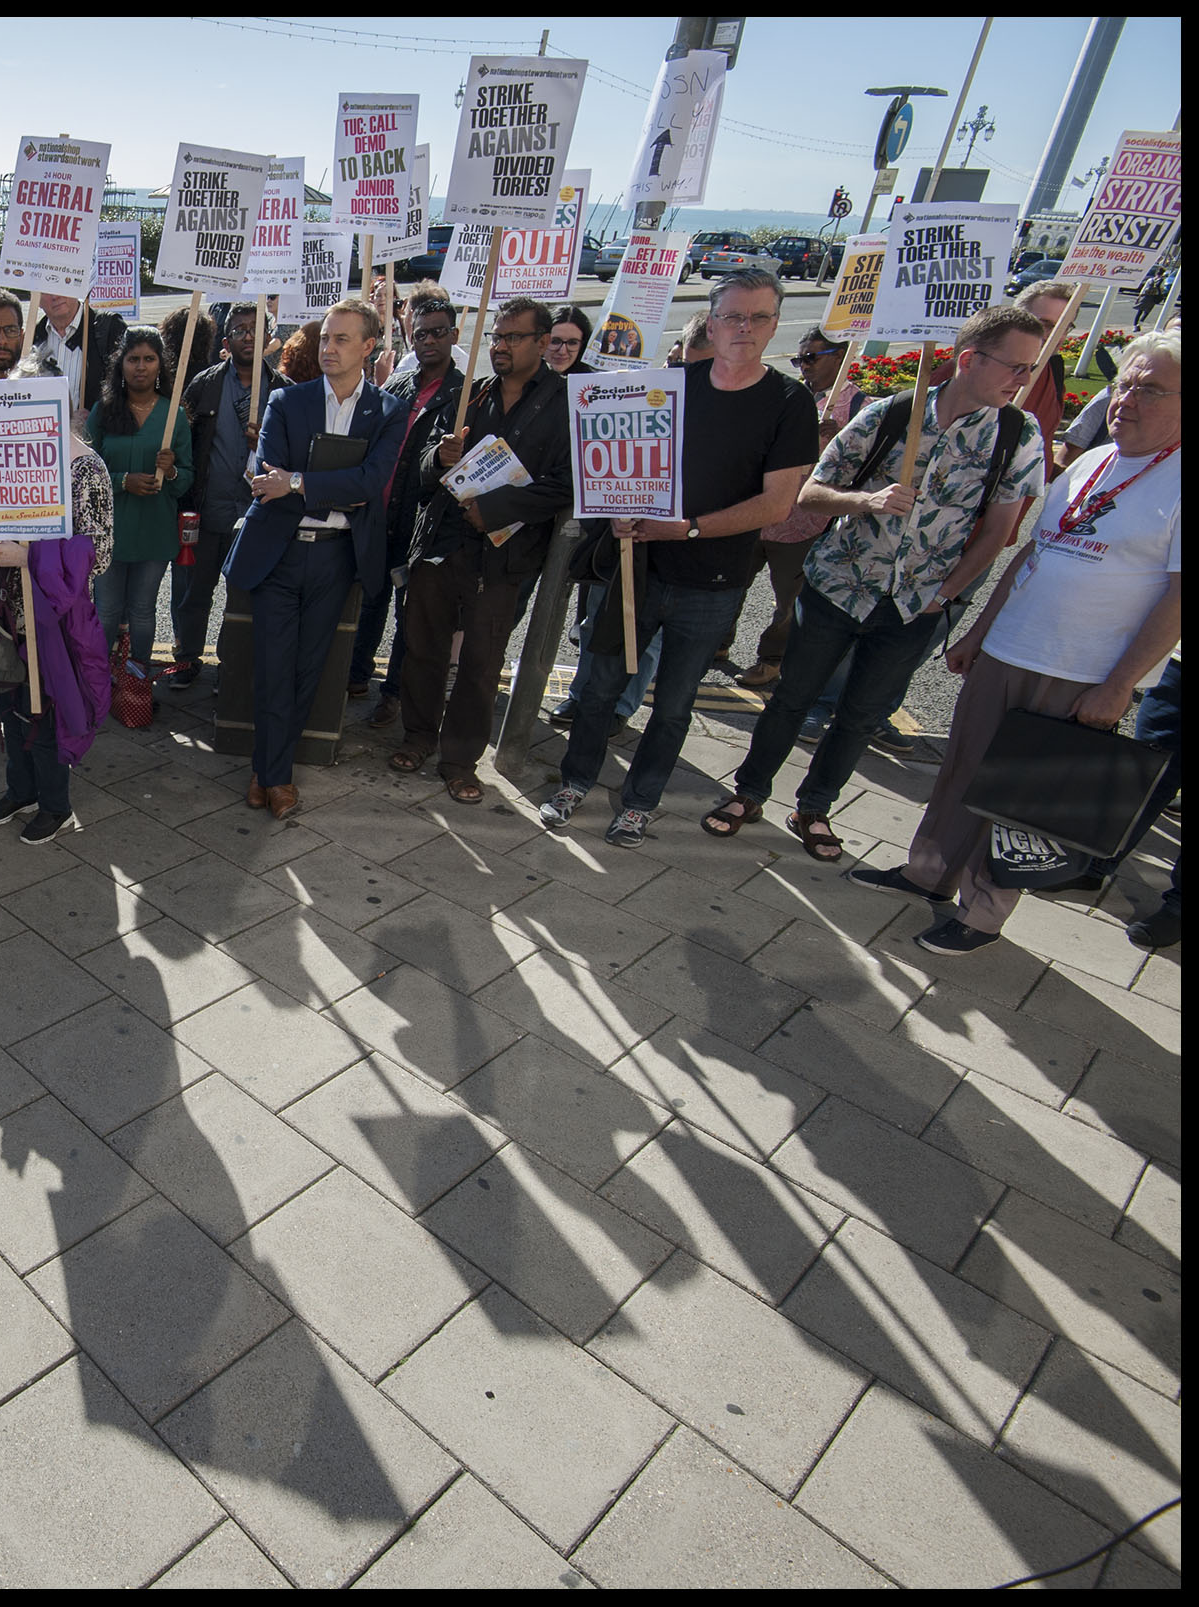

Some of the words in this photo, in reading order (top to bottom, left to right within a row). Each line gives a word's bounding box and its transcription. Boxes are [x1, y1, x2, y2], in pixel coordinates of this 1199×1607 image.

[477, 82, 534, 107] STRIKE
[343, 117, 367, 137] TUC:
[369, 112, 398, 133] CALL
[470, 103, 548, 129] TOGETHER
[39, 143, 81, 155] nationalshop
[354, 133, 386, 154] DEMO
[467, 122, 560, 159] AGAINST
[37, 152, 101, 168] stewardsnetwork
[338, 154, 358, 182] TO
[362, 147, 406, 179] BACK
[492, 156, 555, 176] DIVIDED
[183, 171, 229, 190] STRIKE
[355, 179, 394, 197] JUNIOR
[492, 176, 551, 197] TORIES!
[661, 177, 693, 192] WAY!
[16, 180, 93, 213] GENERAL
[178, 189, 239, 208] TOGETHER
[351, 198, 399, 215] DOCTORS
[20, 211, 83, 242] STRIKE
[175, 207, 249, 232] AGAINST
[903, 224, 965, 247] STRIKE
[1080, 214, 1174, 249] RESIST!
[15, 239, 41, 249] AGAINST
[42, 242, 80, 254] AUSTERITY
[196, 232, 245, 252] DIVIDED
[502, 229, 572, 265] OUT!
[195, 250, 242, 269] TORIES!
[659, 249, 679, 263] THE
[897, 241, 981, 264] TOGETHER
[1071, 247, 1089, 258] take
[1089, 246, 1106, 258] the
[1106, 250, 1145, 264] wealth
[6, 258, 85, 276] www.shopstewards.net
[98, 261, 133, 275] EFEND
[499, 268, 521, 278] LET'S
[522, 268, 537, 277] ALL
[539, 267, 568, 277] STRIKE
[650, 263, 675, 276] OUT!
[895, 256, 995, 288] AGAINST
[1063, 263, 1077, 274] off
[1089, 264, 1107, 276] 1%
[91, 287, 133, 298] STRUGGLE
[305, 281, 341, 296] DIVIDED
[511, 280, 552, 289] TOGETHER
[925, 283, 992, 301] DIVIDED
[837, 291, 874, 305] DEFEND
[592, 385, 646, 394] Socialist
[581, 410, 671, 439] TORIES
[468, 468, 486, 482] TRADE
[486, 450, 508, 471] UNIONS
[476, 449, 497, 467] TAMILS
[485, 456, 512, 477] SOLIDARITY
[584, 440, 669, 478] OUT!
[586, 481, 612, 491] LET'S
[614, 481, 633, 491] ALL
[635, 481, 670, 492] STRIKE
[603, 494, 654, 505] TOGETHER
[16, 510, 59, 519] Socialists
[585, 506, 670, 516] www.socialistparty.org.uk
[1083, 540, 1109, 554] NOW!
